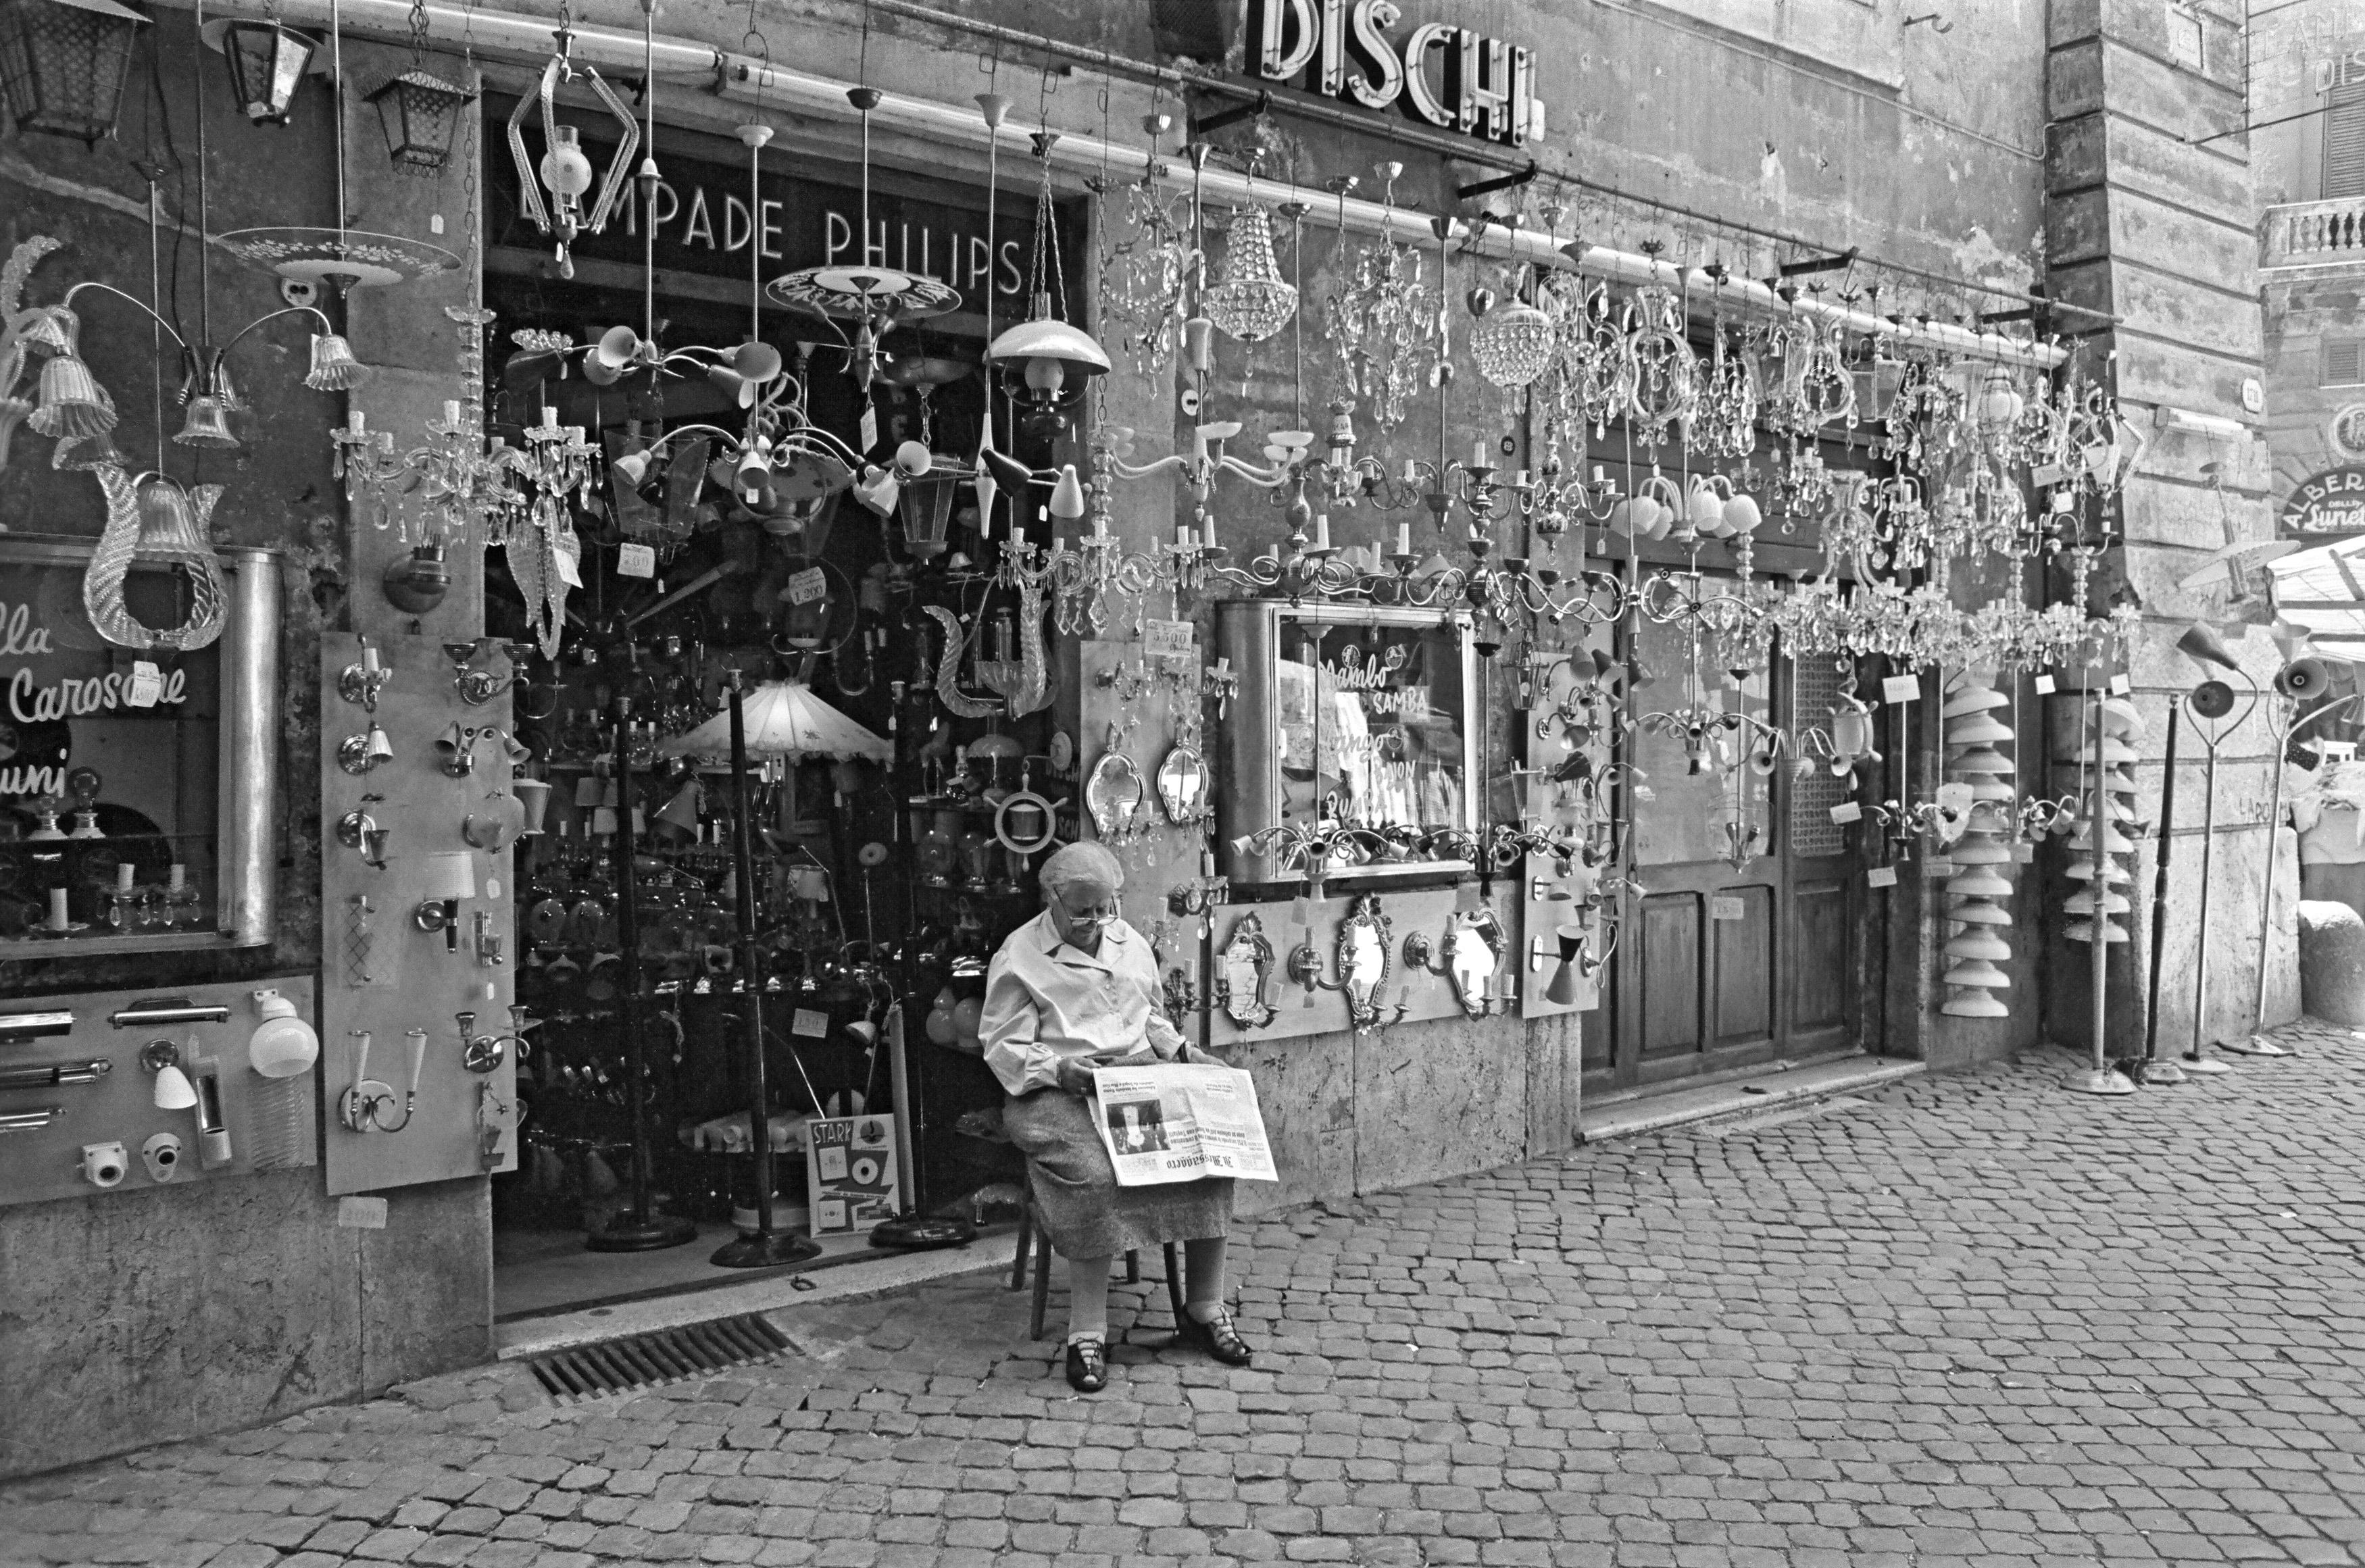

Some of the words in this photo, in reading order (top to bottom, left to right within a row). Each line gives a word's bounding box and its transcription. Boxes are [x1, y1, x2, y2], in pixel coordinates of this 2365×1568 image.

[1261, 0, 1535, 147] DISCHI
[520, 170, 782, 259] LMPADE
[827, 210, 1022, 293] PHILIPS
[9, 667, 186, 723] Carosoe
[1372, 686, 1427, 714] SAMBA
[814, 1122, 852, 1144] STARK
[1166, 1154, 1224, 1169] Messaggero
